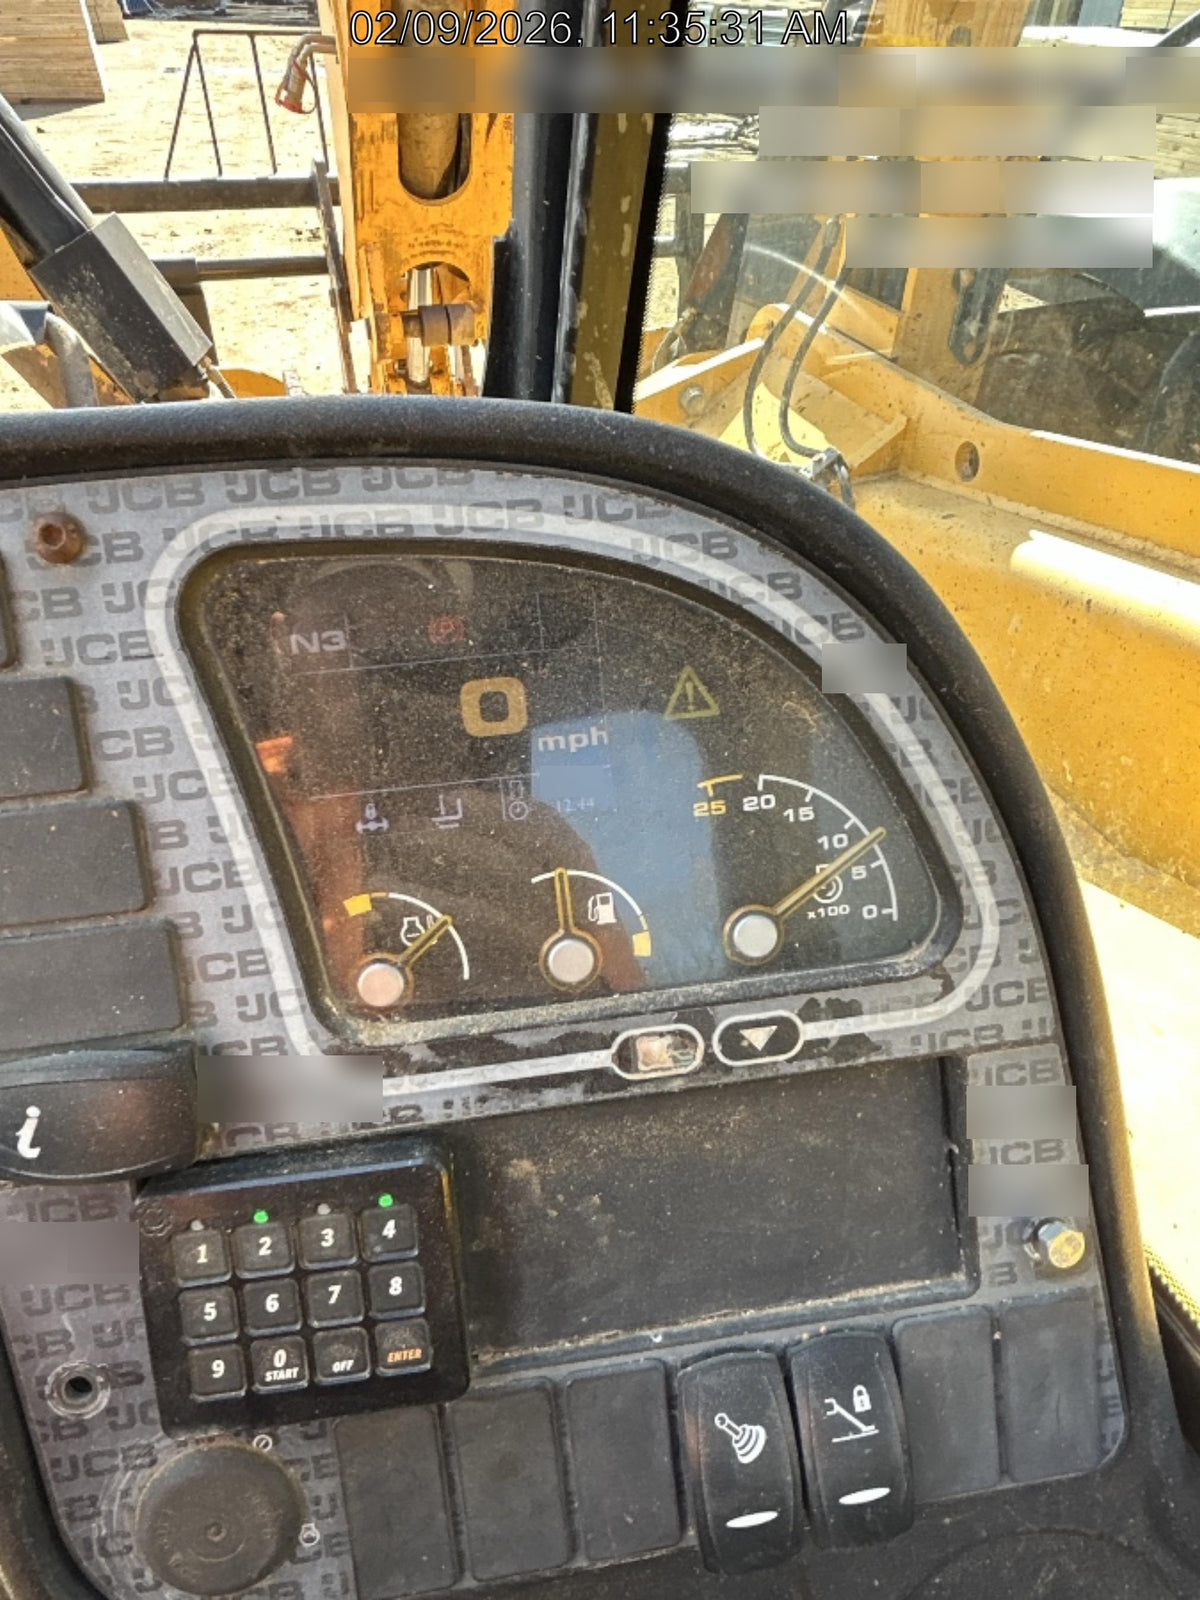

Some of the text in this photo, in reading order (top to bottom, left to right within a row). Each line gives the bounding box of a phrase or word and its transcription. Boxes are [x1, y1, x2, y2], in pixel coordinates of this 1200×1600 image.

[86, 478, 205, 514] JCB
[225, 470, 342, 503] JCB
[290, 630, 347, 655] N3
[460, 676, 527, 737] 0
[95, 725, 175, 762] CB
[538, 726, 609, 753] mph
[693, 800, 727, 818] 25
[742, 794, 777, 812] 20
[783, 806, 815, 823] 15
[817, 833, 849, 850] 10
[851, 865, 867, 881] 5
[807, 904, 850, 919] x100
[862, 905, 878, 920] 0
[320, 1228, 335, 1247] 3
[382, 1219, 396, 1239] 4
[196, 1244, 208, 1264] 1
[258, 1236, 272, 1256] 2
[327, 1285, 342, 1304] 7
[388, 1276, 402, 1295] 8
[203, 1302, 217, 1321] 5
[265, 1293, 279, 1313] 6
[273, 1349, 287, 1368] 0
[387, 1348, 422, 1363] ENTER
[211, 1360, 225, 1379] 9
[265, 1368, 299, 1382] START
[332, 1359, 354, 1373] OFF
[51, 1443, 158, 1483] JCB
